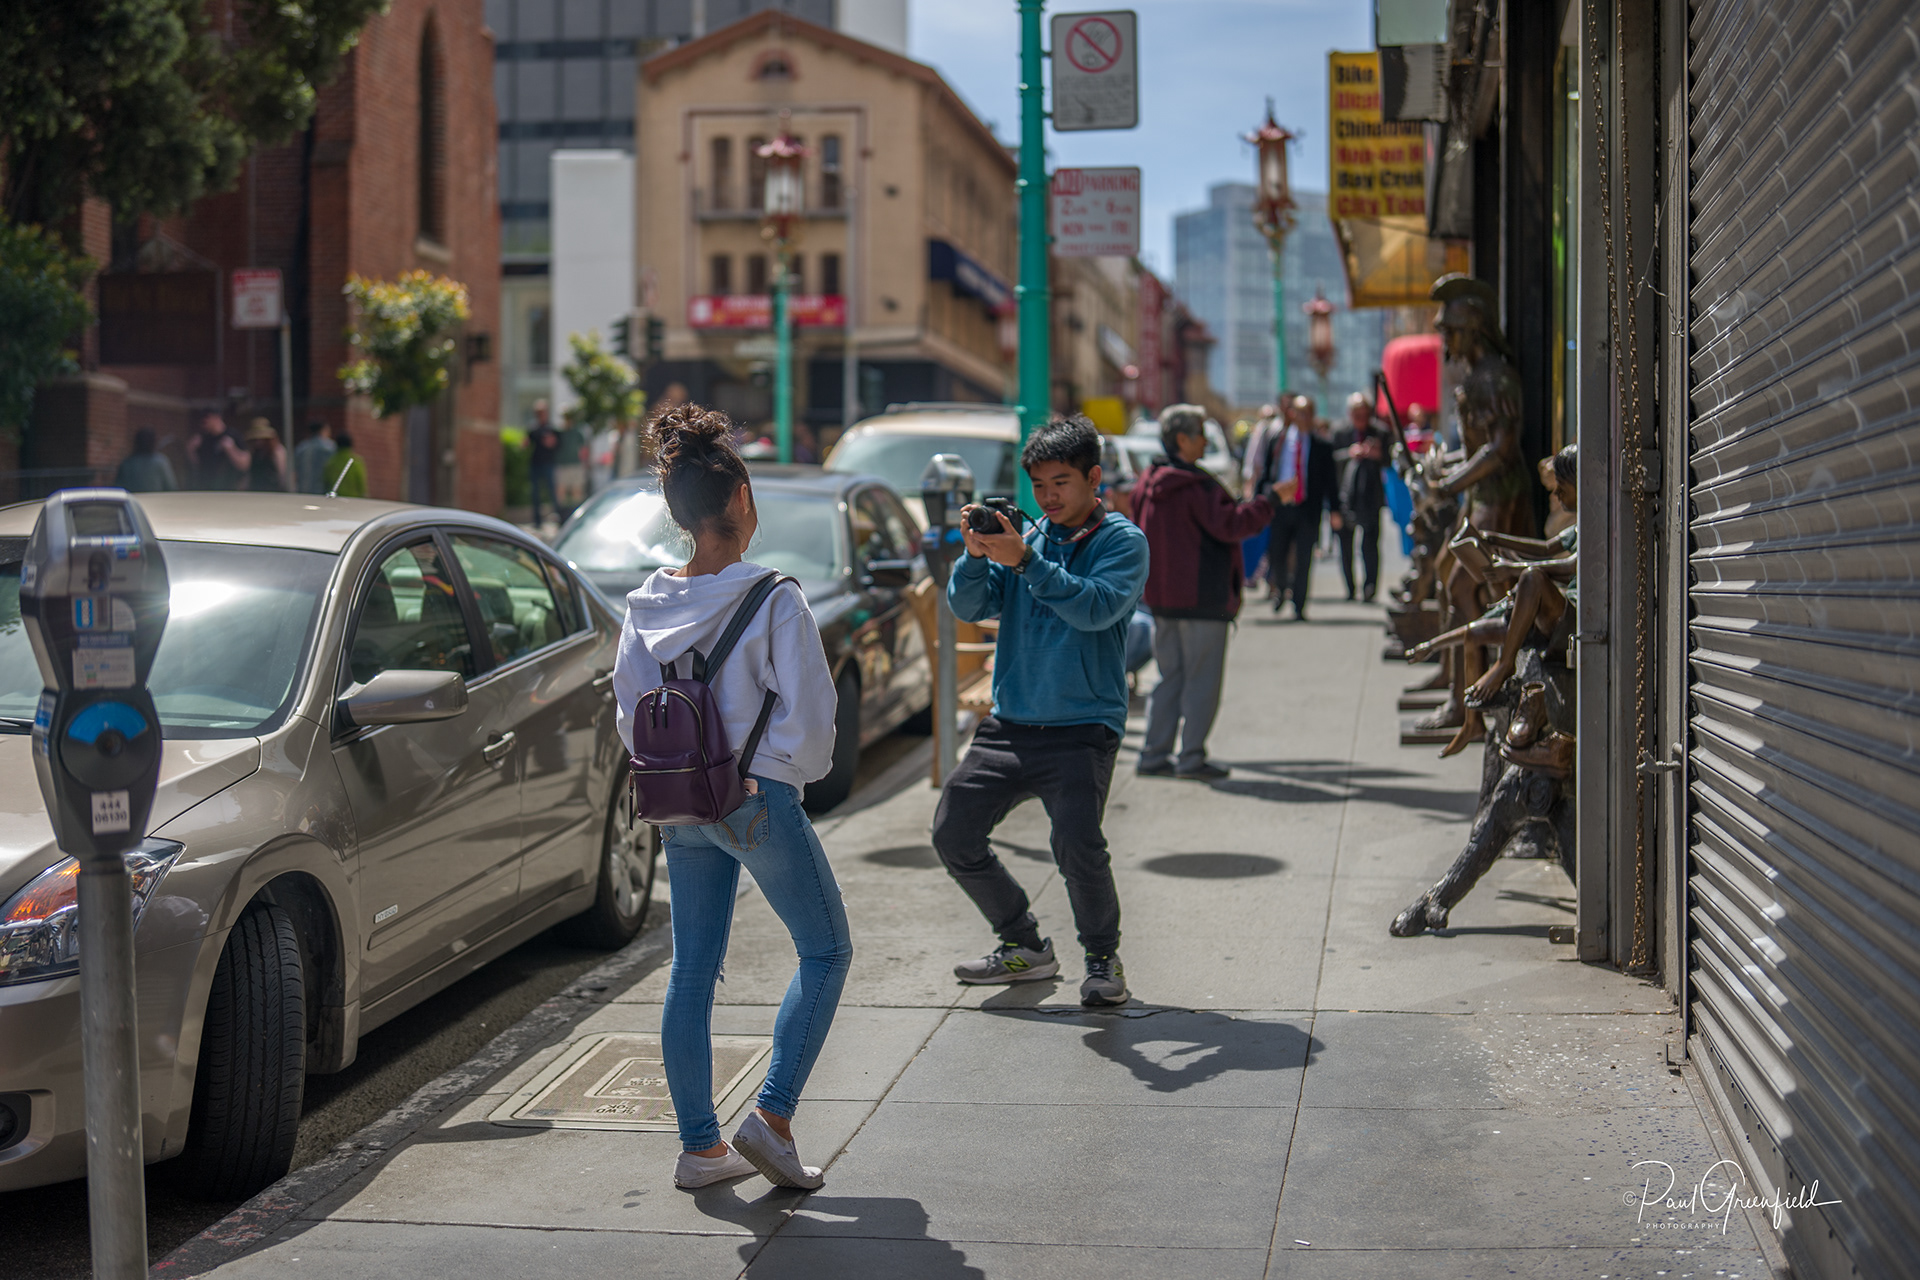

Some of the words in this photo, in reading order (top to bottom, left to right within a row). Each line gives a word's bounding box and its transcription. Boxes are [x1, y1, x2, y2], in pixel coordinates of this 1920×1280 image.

[1335, 65, 1374, 83] Bike
[1084, 173, 1137, 192] PARKING
[1336, 168, 1375, 191] Bay
[1336, 196, 1378, 217] City
